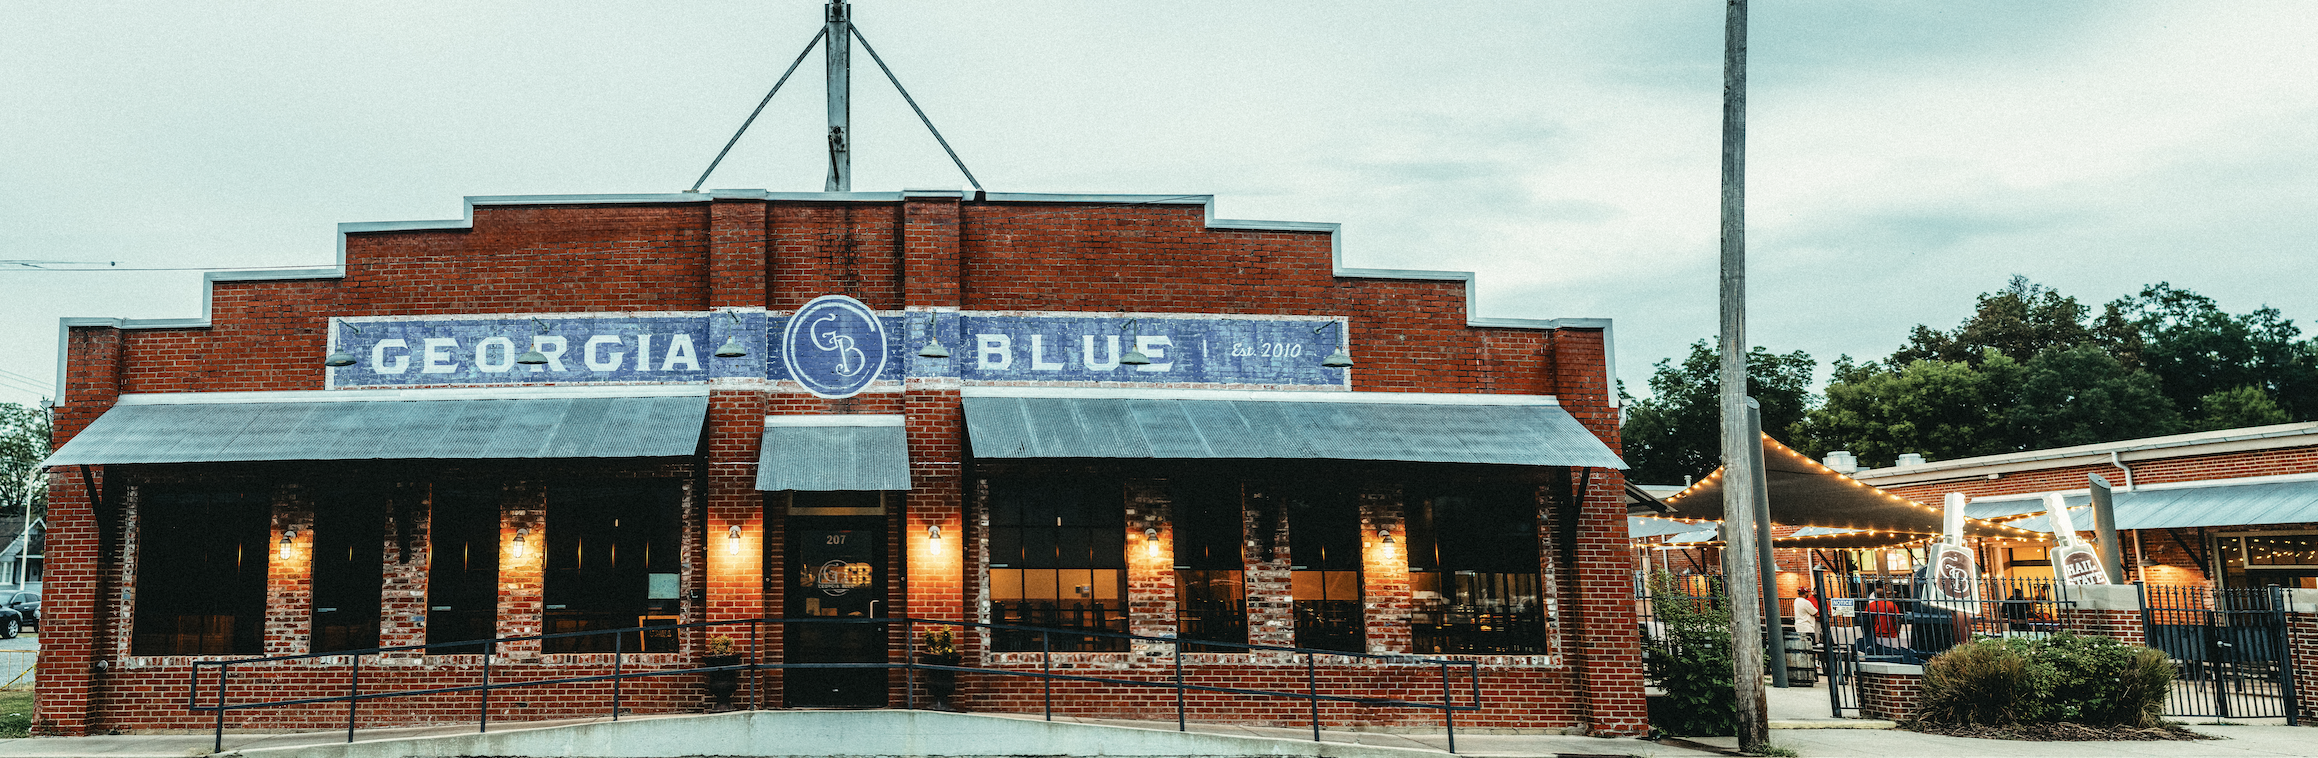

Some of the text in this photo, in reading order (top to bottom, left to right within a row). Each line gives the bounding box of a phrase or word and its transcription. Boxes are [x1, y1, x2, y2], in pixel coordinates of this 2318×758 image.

[810, 313, 866, 377] GB
[1231, 342, 1302, 358] Est. 2010
[371, 333, 1174, 375] GEORGIA BLUE
[826, 534, 846, 545] 207
[843, 562, 873, 587] GB
[2065, 560, 2097, 576] HAIL
[2068, 571, 2105, 585] STATE
